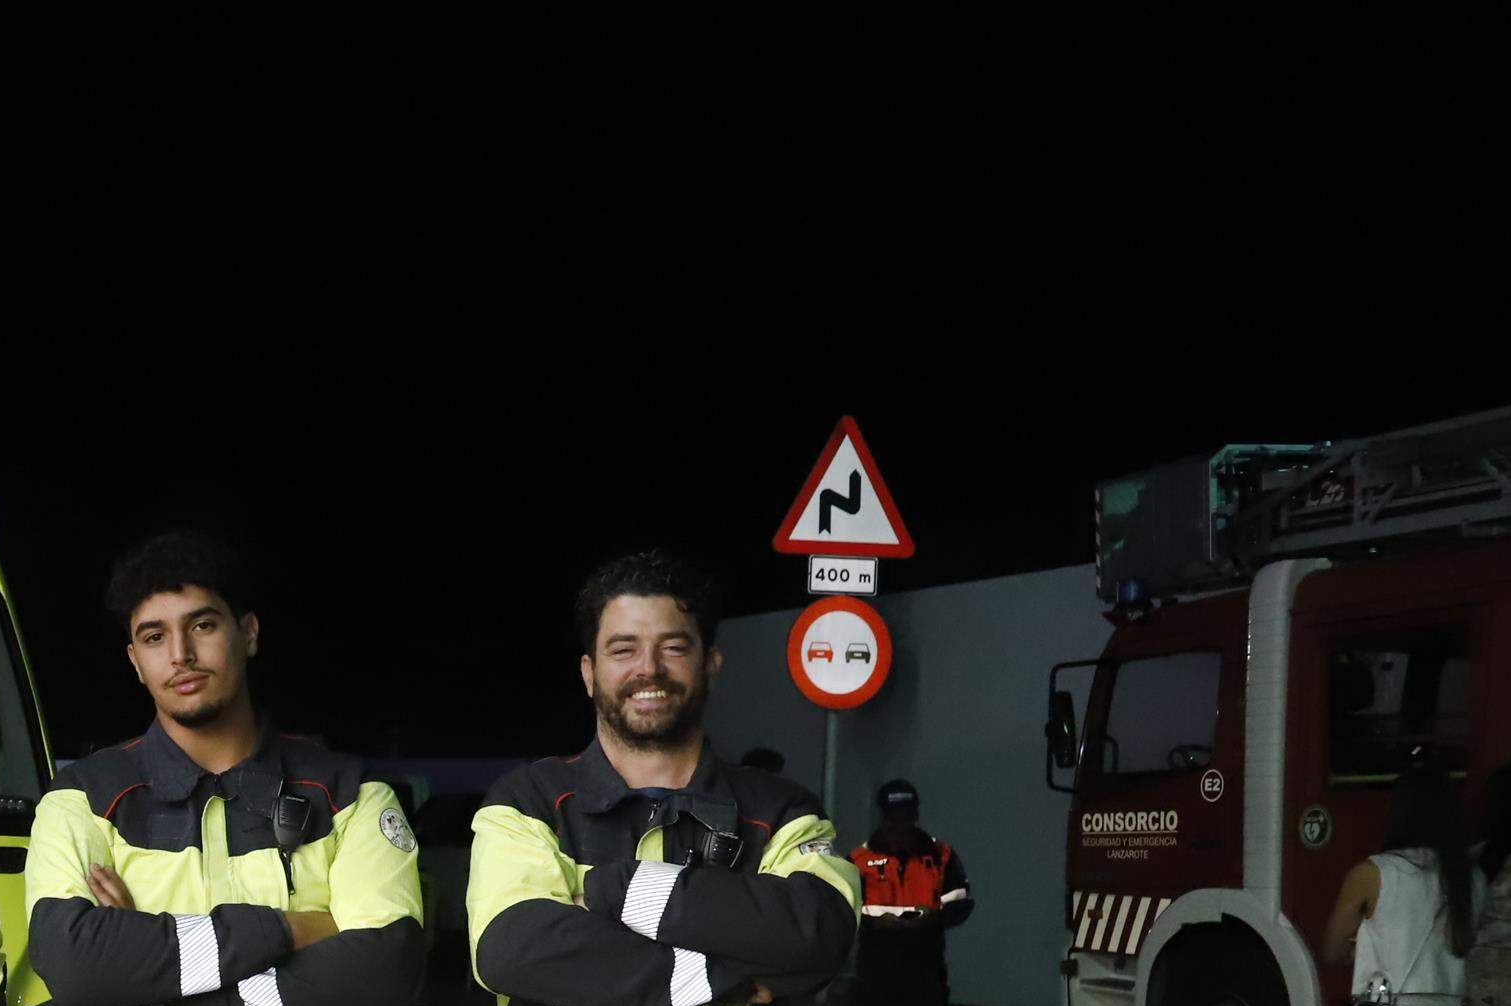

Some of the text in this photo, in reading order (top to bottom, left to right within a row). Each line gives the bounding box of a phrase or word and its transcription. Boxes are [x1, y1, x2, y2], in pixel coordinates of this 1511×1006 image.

[815, 567, 871, 583] 400 m
[1204, 778, 1221, 791] E2
[1081, 810, 1179, 832] CONSORCIO
[1081, 836, 1122, 848] SEGURIDAD
[1107, 849, 1149, 860] LANZAROTE
